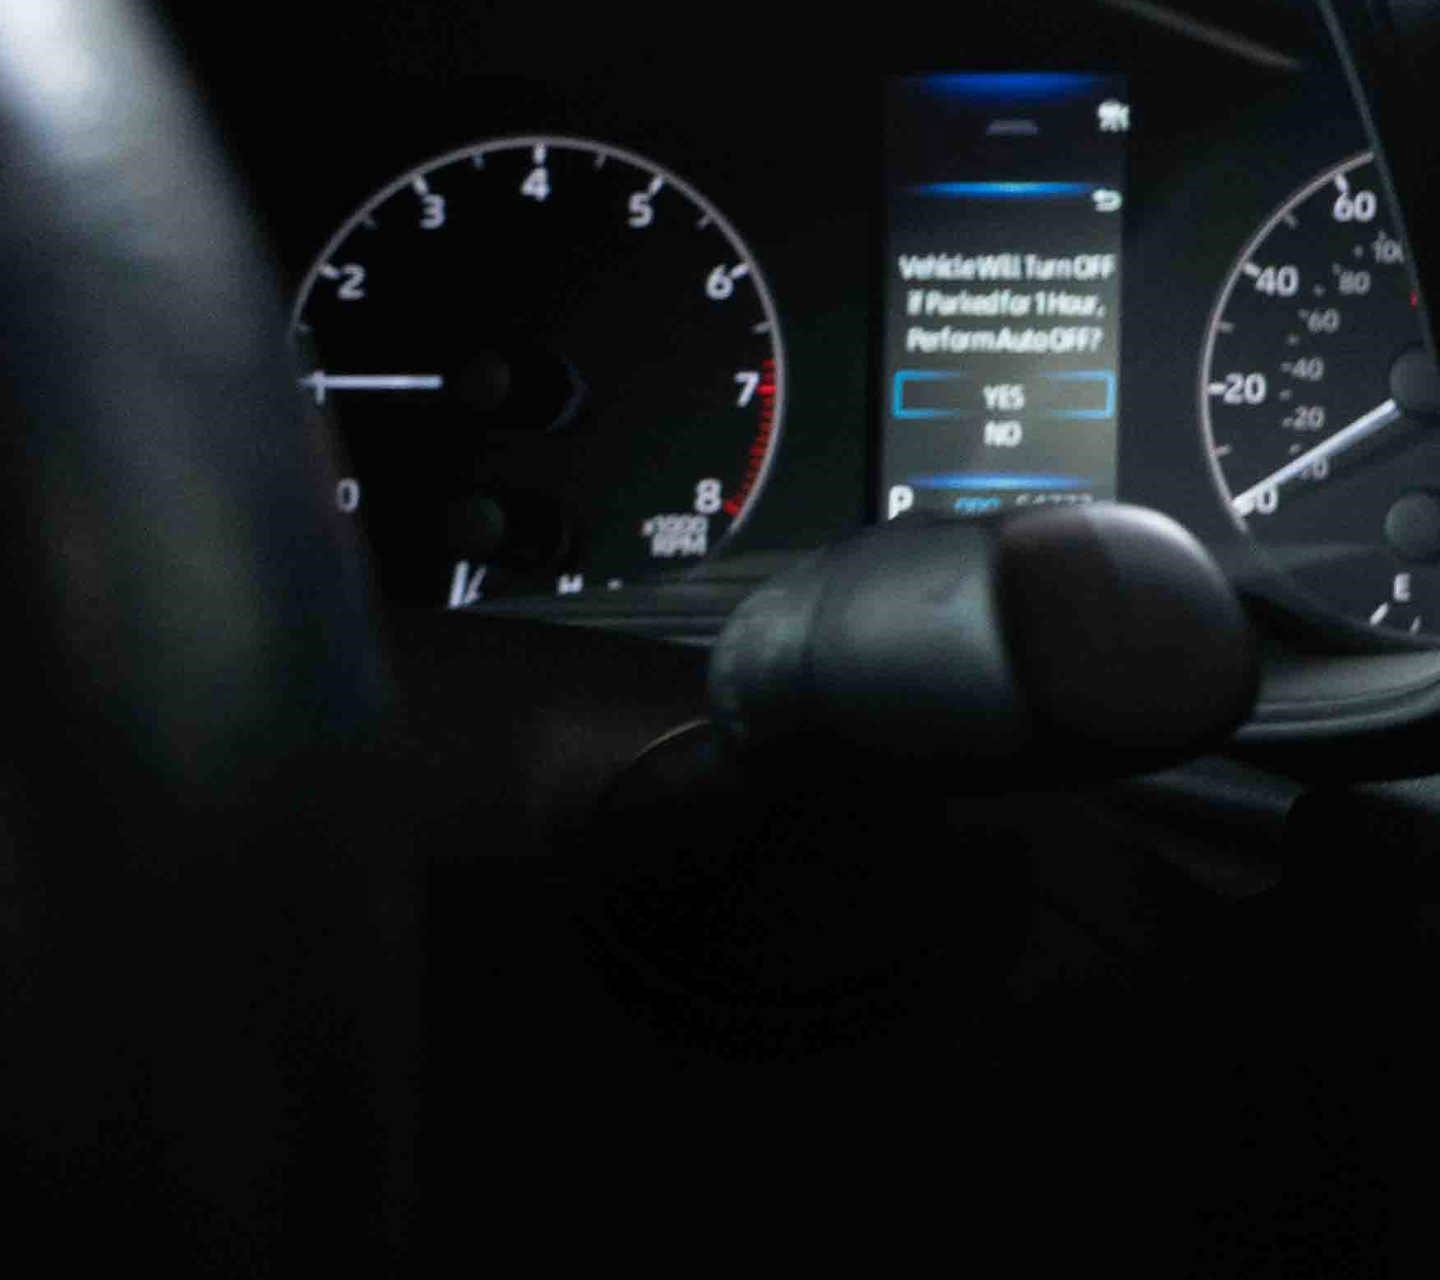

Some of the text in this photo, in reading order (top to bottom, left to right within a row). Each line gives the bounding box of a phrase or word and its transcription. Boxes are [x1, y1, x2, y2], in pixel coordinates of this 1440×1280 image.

[521, 168, 549, 202] 4
[421, 194, 446, 229] 3
[629, 193, 654, 228] 5
[1333, 190, 1377, 222] 60
[336, 265, 366, 300] 2
[899, 253, 1115, 281] Vehicle Will Turn OFF
[1255, 266, 1300, 297] 40
[705, 266, 733, 300] 6
[1338, 271, 1372, 296] 80
[925, 289, 999, 315] Parked
[1000, 289, 1031, 315] for
[1306, 308, 1340, 333] 60
[906, 325, 1103, 353] Perform Auto OFF?
[1291, 358, 1325, 382] 40
[734, 373, 759, 407] 7
[982, 384, 1025, 412] YES
[1223, 372, 1266, 404] 20
[984, 420, 1023, 448] NO
[1291, 406, 1325, 431] 20
[337, 479, 361, 513] 0
[694, 479, 723, 514] 8
[889, 486, 914, 520] P
[1393, 571, 1411, 602] E
